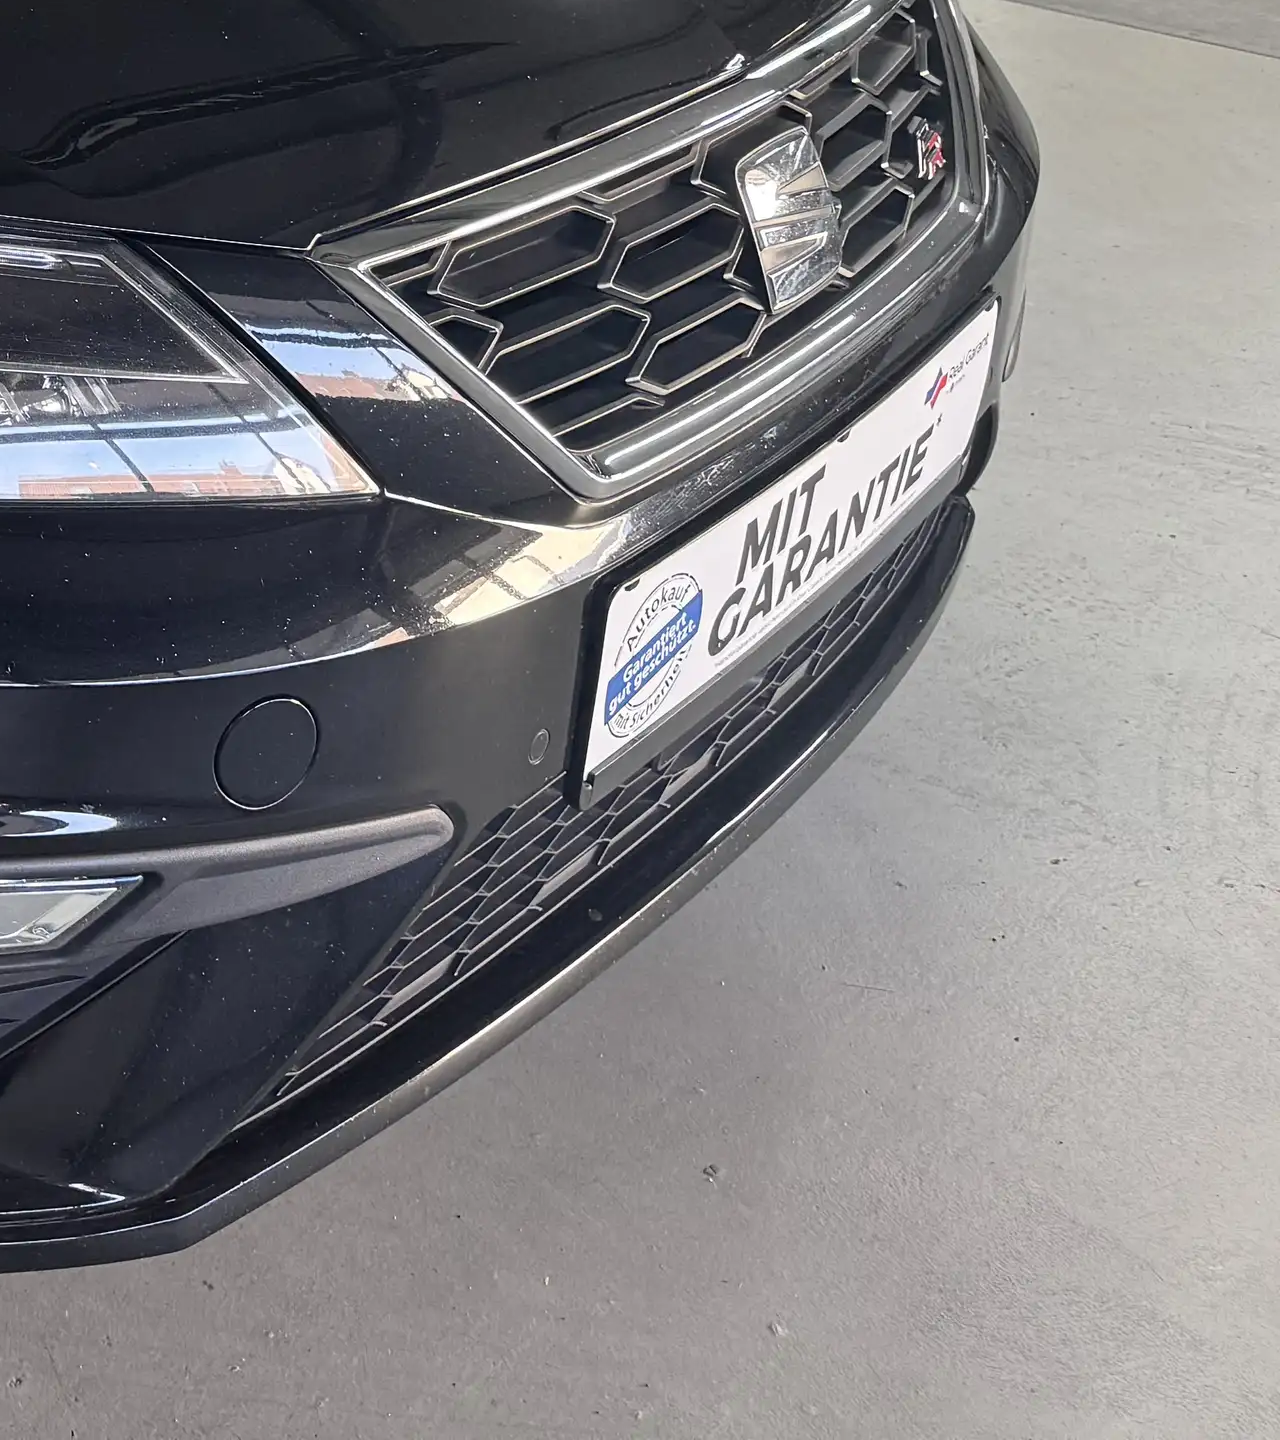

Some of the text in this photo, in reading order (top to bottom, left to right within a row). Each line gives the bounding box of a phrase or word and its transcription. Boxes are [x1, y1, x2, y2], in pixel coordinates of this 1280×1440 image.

[735, 463, 826, 587] MIT
[623, 611, 687, 683] Garantiert
[626, 583, 692, 653] Autokauf
[608, 685, 632, 716] gut
